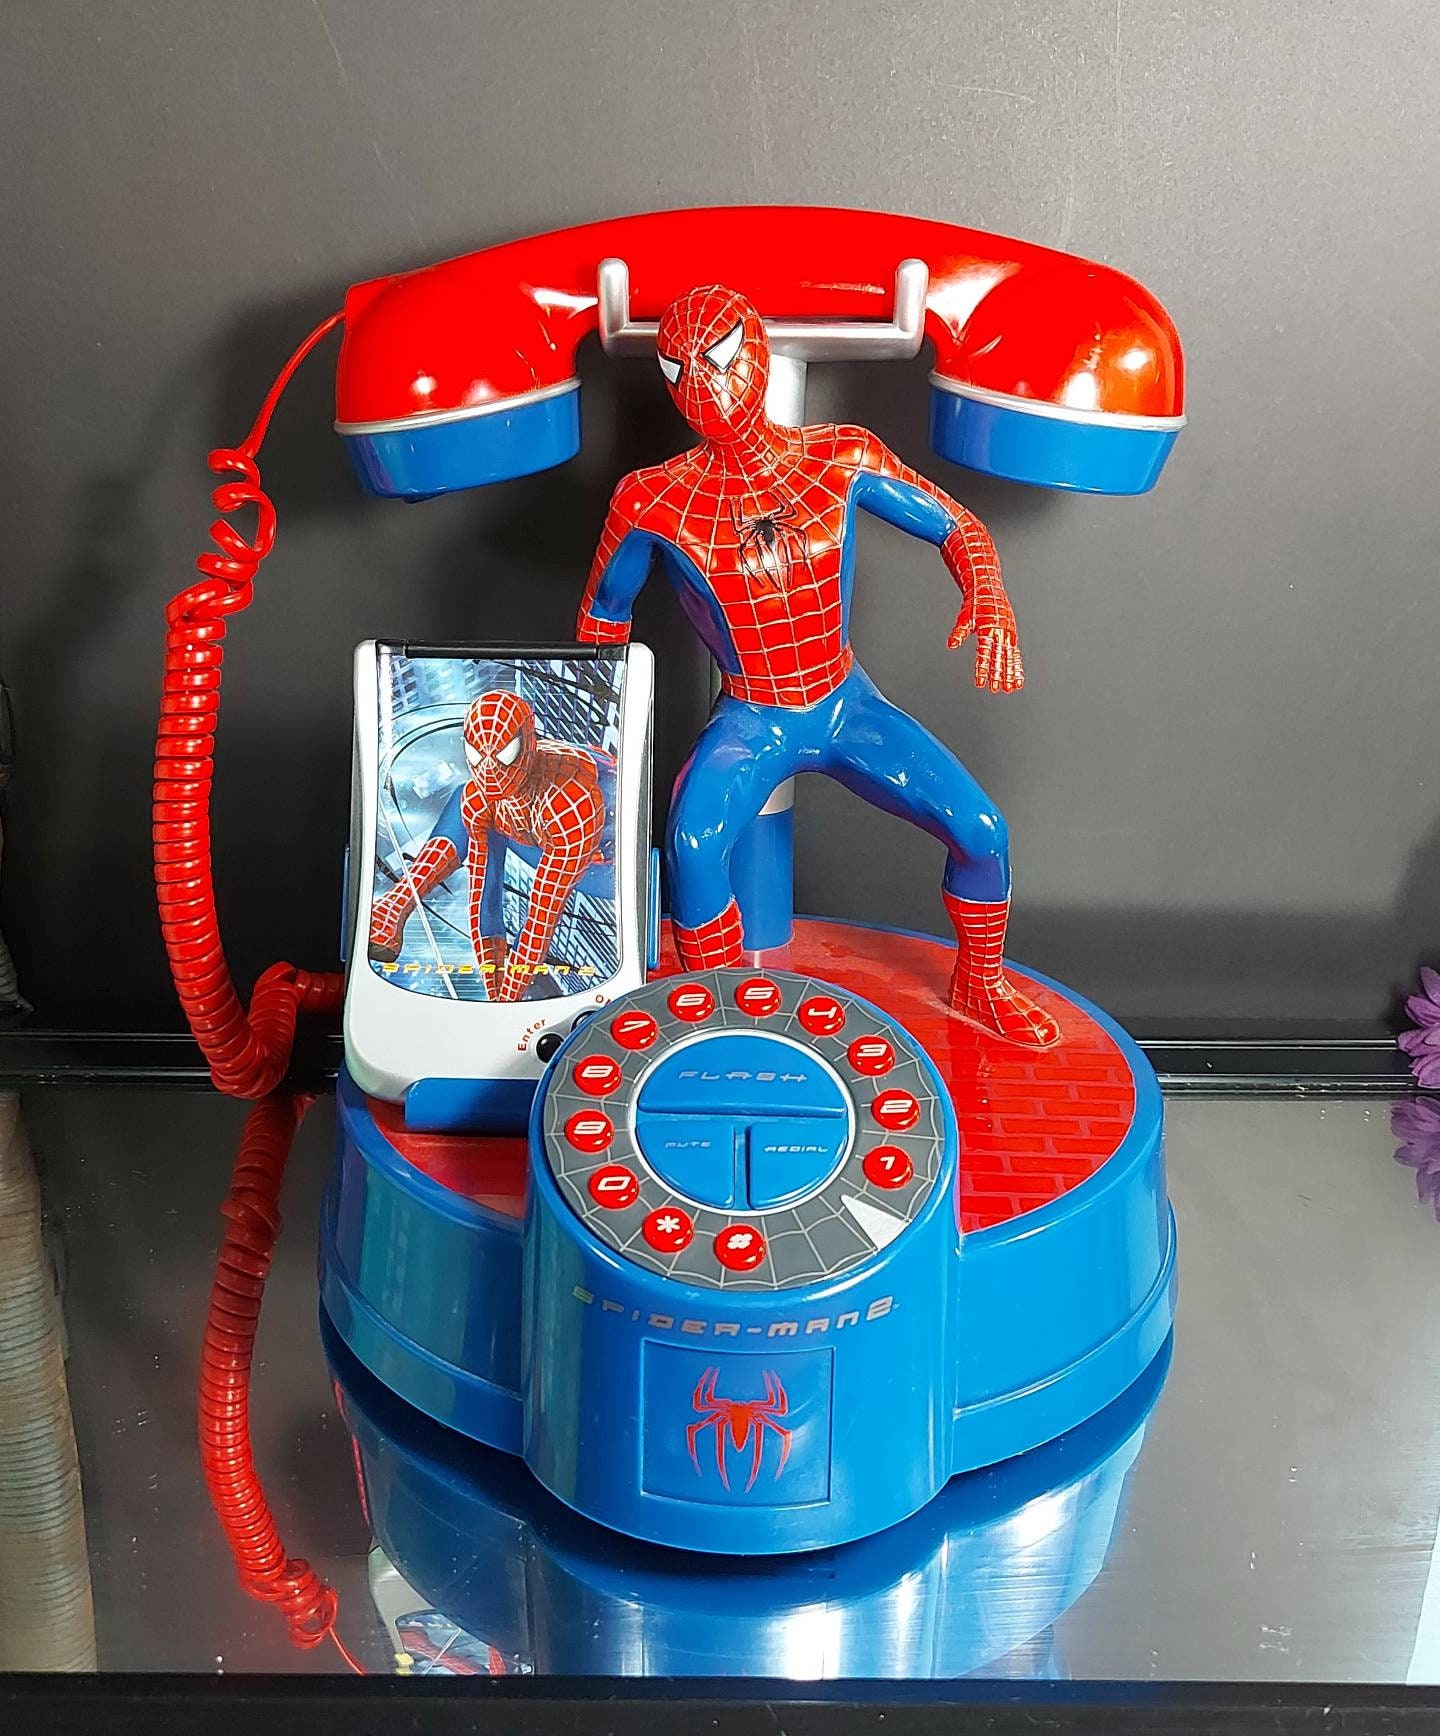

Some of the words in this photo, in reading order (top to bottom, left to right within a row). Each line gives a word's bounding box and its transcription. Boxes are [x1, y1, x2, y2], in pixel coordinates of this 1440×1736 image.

[677, 993, 706, 1006] 6
[745, 987, 775, 1000] 5
[808, 1006, 836, 1018] 4
[619, 1019, 650, 1033] 7
[517, 1018, 547, 1052] Enter
[856, 1043, 887, 1057] 3
[582, 1065, 613, 1078] 8
[678, 1071, 808, 1083] FLASH
[880, 1099, 912, 1113] 2
[575, 1120, 606, 1134] 9
[664, 1141, 712, 1149] MUTE
[880, 1155, 895, 1169] 1
